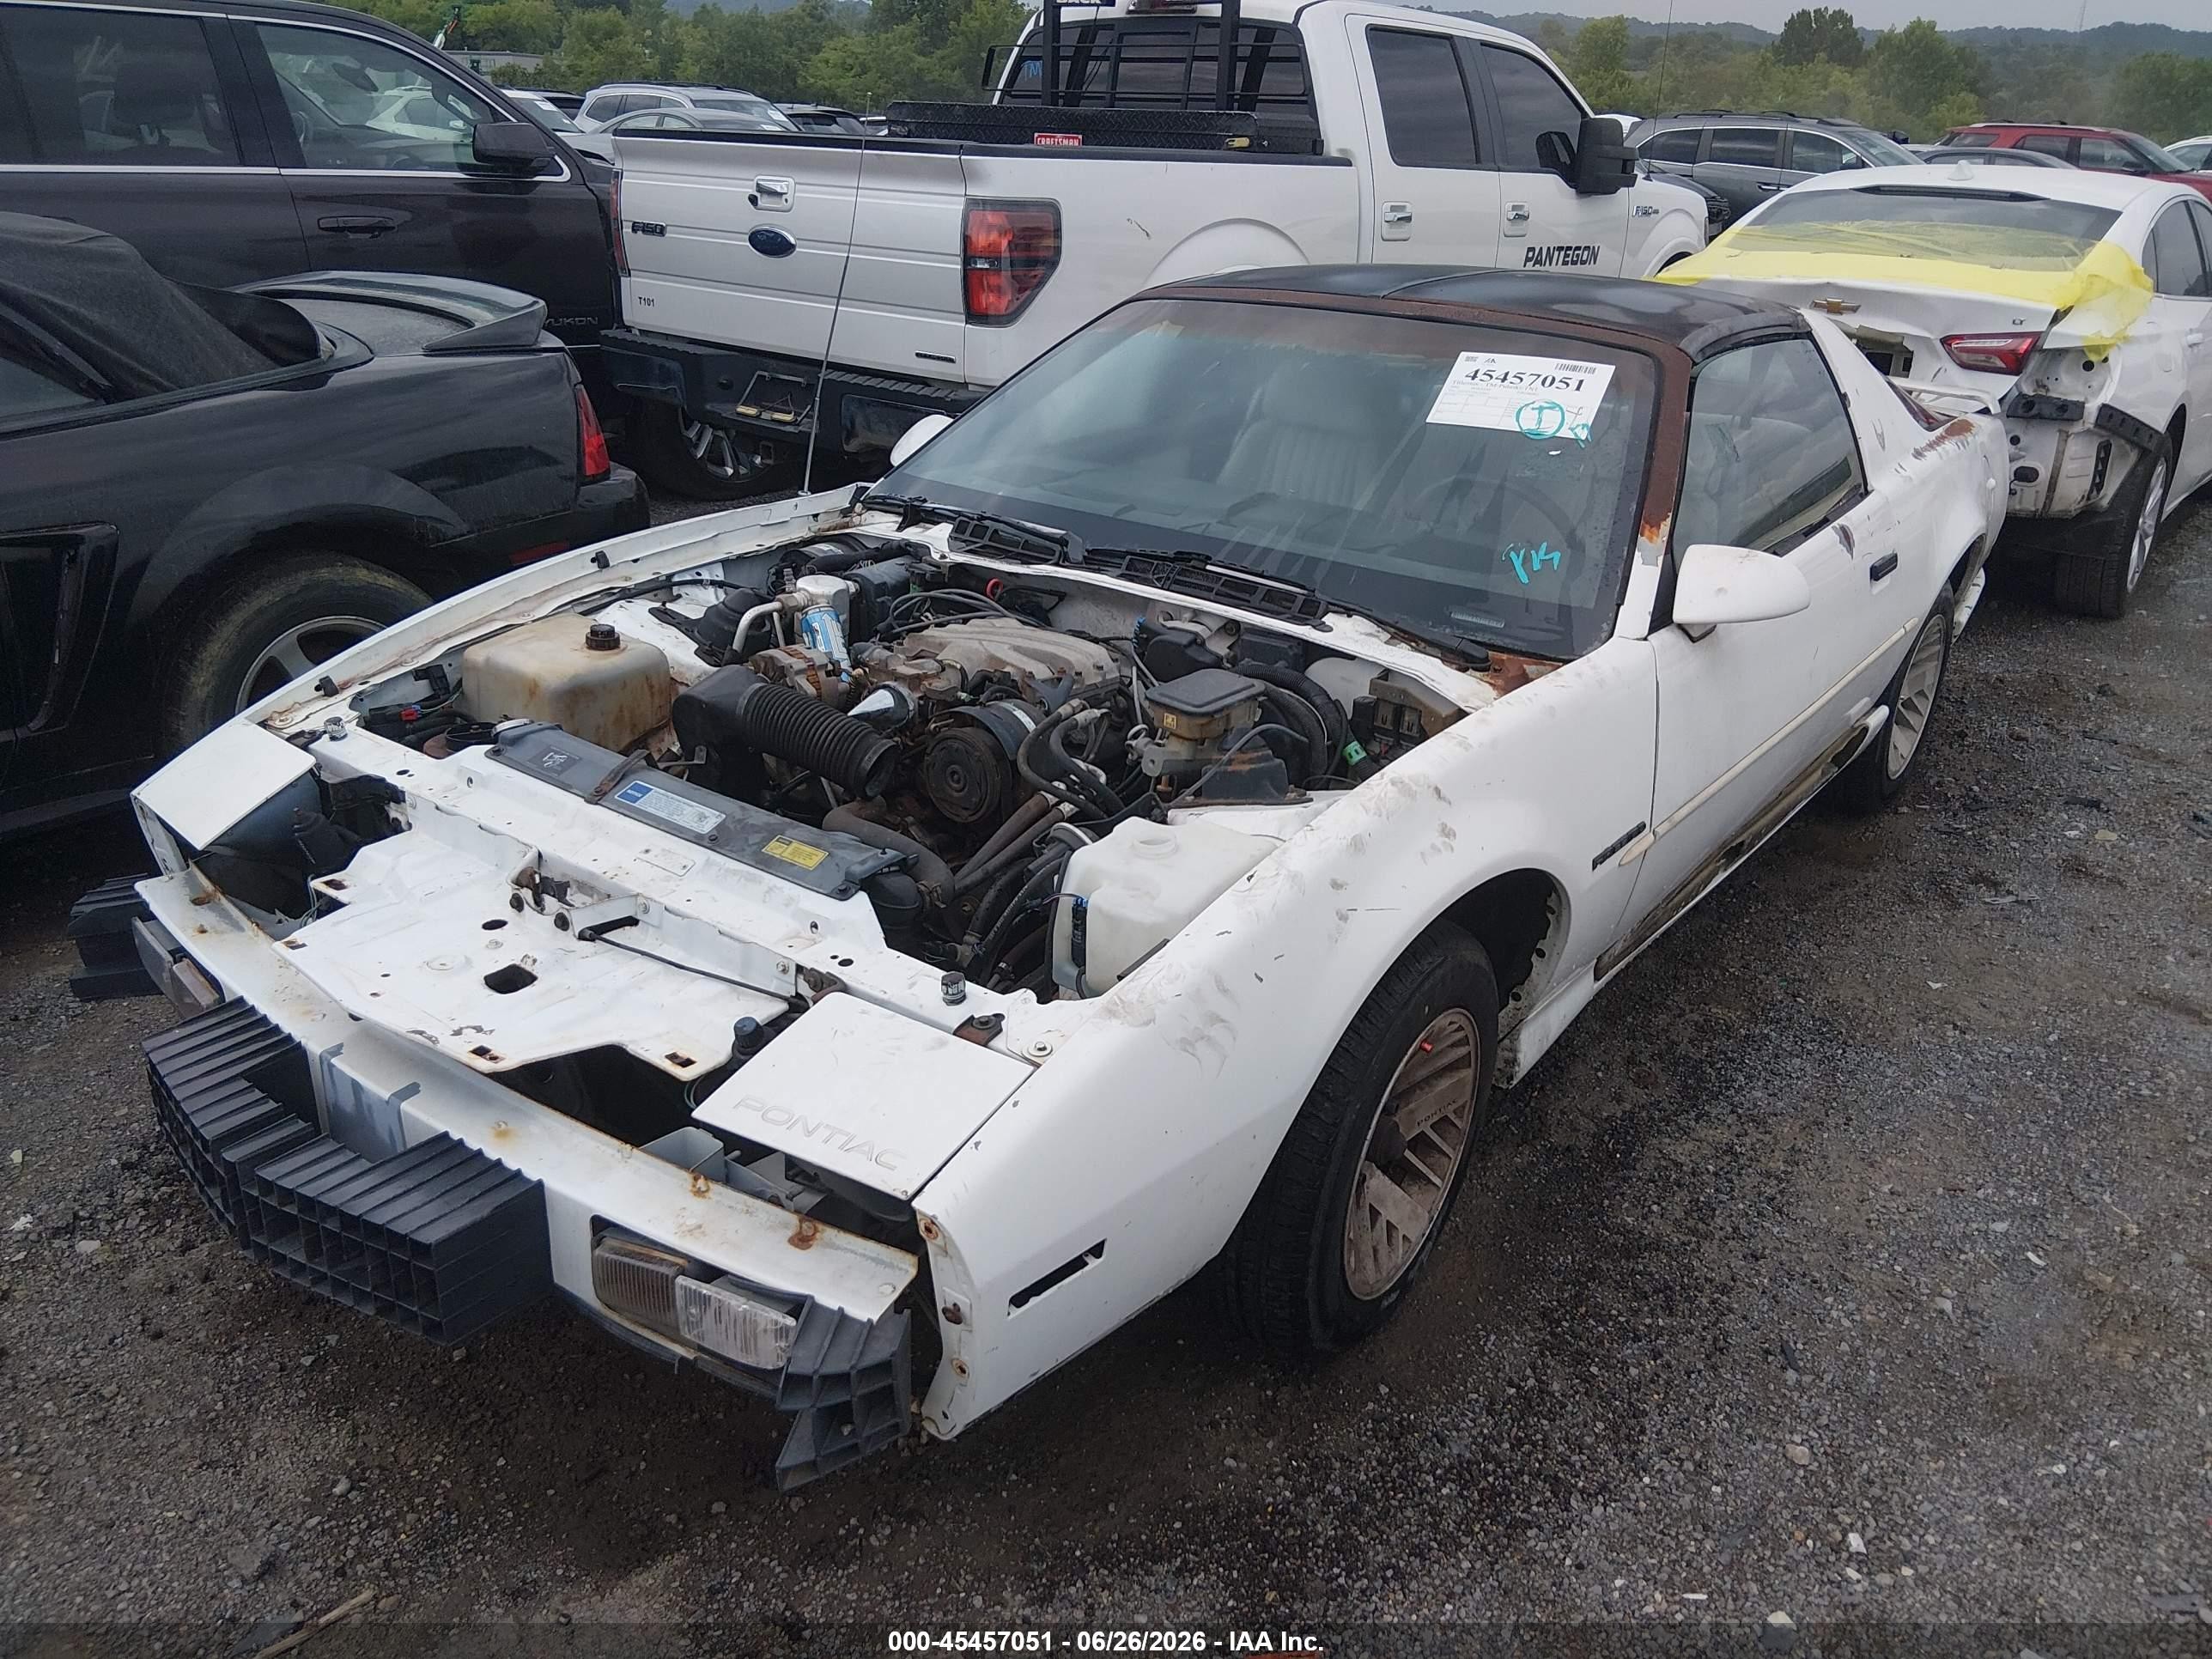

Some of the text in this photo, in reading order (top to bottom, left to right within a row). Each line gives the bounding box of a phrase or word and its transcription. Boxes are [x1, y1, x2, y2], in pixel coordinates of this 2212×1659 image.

[1036, 137, 1079, 147] CRAFTSMAN
[1523, 245, 1601, 268] PANTEGON
[638, 296, 655, 307] T101
[1465, 368, 1586, 392] 45457051
[732, 1094, 907, 1172] PONTIAC
